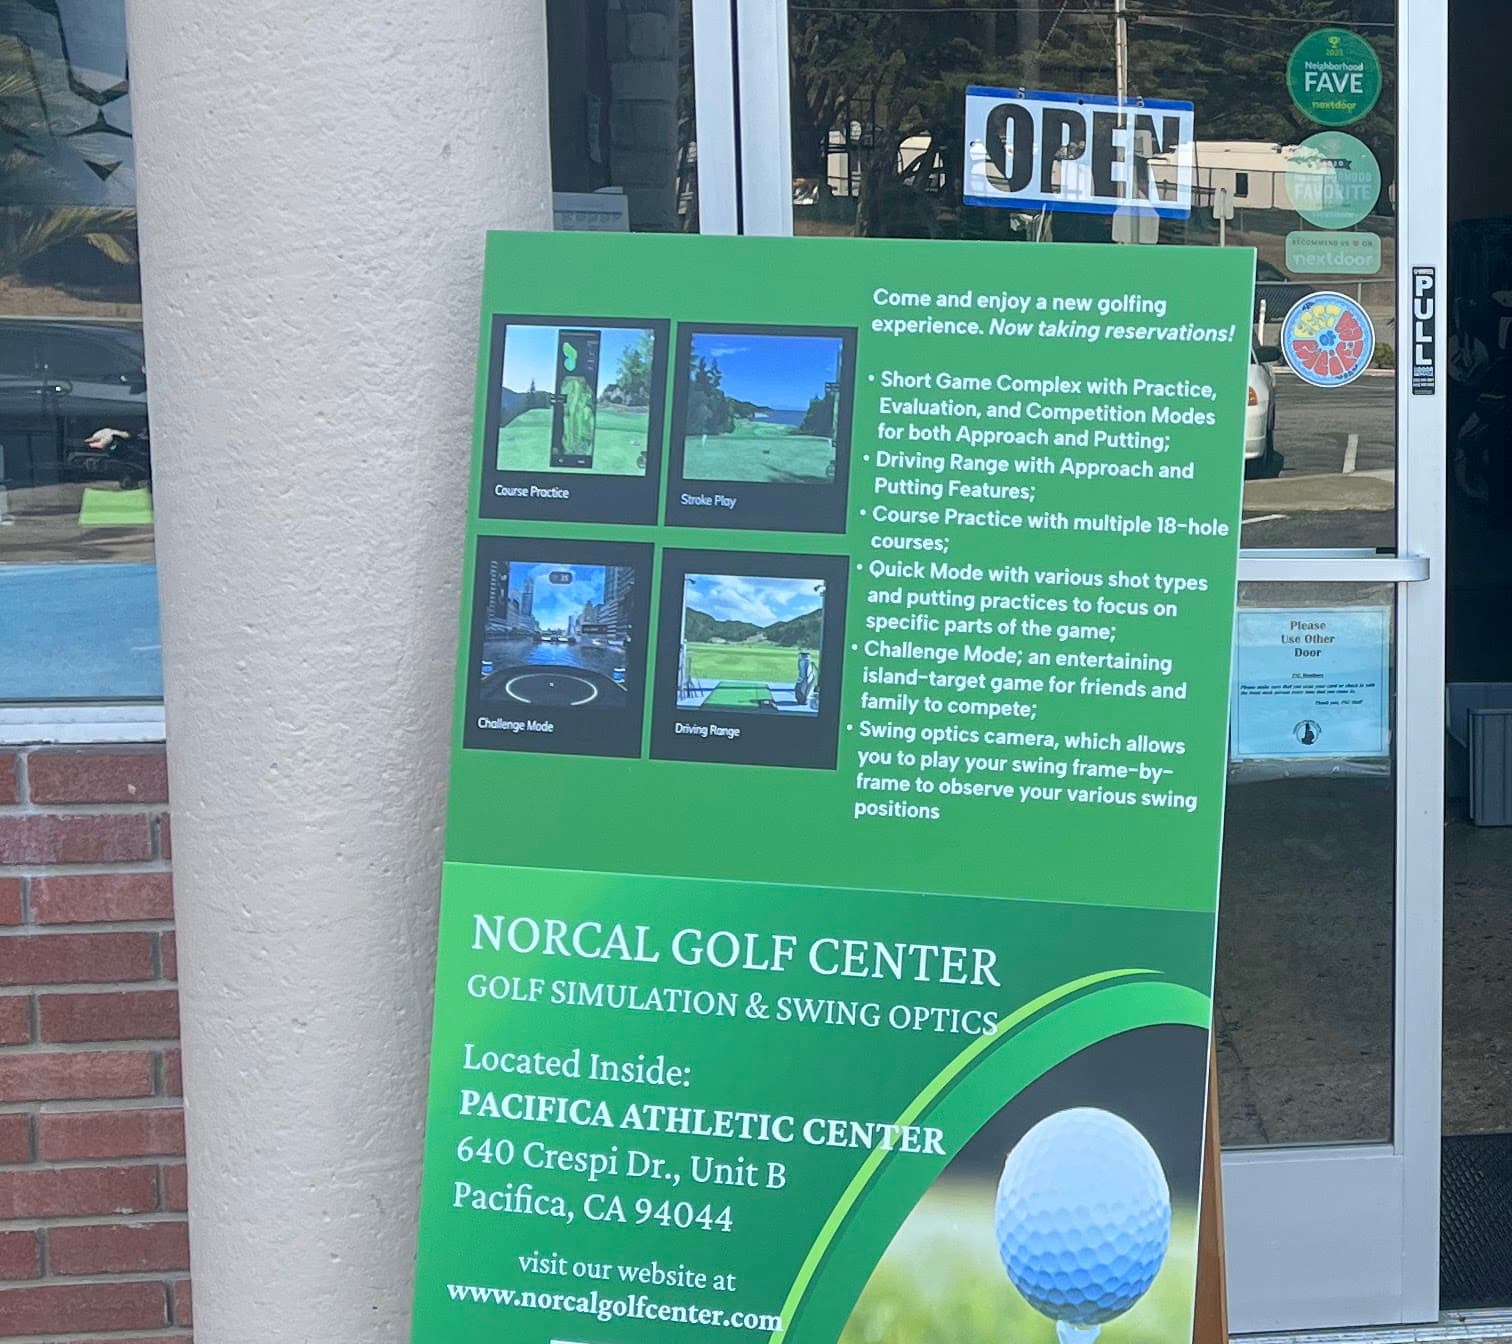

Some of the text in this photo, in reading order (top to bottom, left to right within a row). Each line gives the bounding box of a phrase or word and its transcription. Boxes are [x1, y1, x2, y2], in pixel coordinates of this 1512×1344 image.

[1304, 61, 1364, 73] Neighborhood
[1304, 71, 1364, 94] FAVE
[1311, 100, 1356, 111] nextdoor
[985, 102, 1181, 203] OPEN
[1294, 183, 1372, 201] FAVORITE
[1292, 251, 1374, 266] nextdoor
[873, 288, 1166, 317] Come and enjoy a new golfing
[872, 316, 1236, 342] experience. Now taking reservations!
[1413, 275, 1434, 366] PULL
[881, 370, 1216, 400] Short Game Complex with Practice,
[880, 397, 1215, 425] Evaluation, and Competition Modes
[878, 422, 1170, 453] for both Approach and Putting;
[876, 451, 1194, 479] Driving Range with Approach and
[495, 484, 569, 498] Course Practice
[681, 494, 736, 509] Stroke Play
[875, 477, 1035, 502] Putting Features;
[873, 505, 1229, 536] Course Practice with multiple 18-hole
[871, 536, 949, 554] courses;
[869, 560, 1208, 594] Quick Mode with various shot types
[868, 587, 1177, 616] and putting practices to focus on
[866, 614, 1116, 642] specific parts of the game;
[1280, 633, 1336, 645] Use Other
[1289, 620, 1327, 631] Please
[864, 640, 1172, 675] Challenge Mode; an entertaining
[1293, 647, 1323, 658] Door
[863, 666, 1187, 699] island-target game for friends and
[861, 692, 1036, 720] family to compete;
[478, 717, 553, 733] Challenge Mode
[675, 723, 740, 739] Driving Range
[860, 721, 1185, 754] Swing optics camera, which allows
[858, 750, 1173, 784] you to play your swing frame-by-
[857, 772, 1197, 812] frame to observe your various swing
[855, 800, 940, 819] positions
[472, 914, 1000, 986] NORCAL GOLF CENTER
[468, 975, 1000, 1037] GOLF SIMULATION & SWING OPTICS
[464, 1044, 690, 1087] Located Inside:
[460, 1090, 946, 1156] PACIFICA ATHLETIC CENTER
[458, 1136, 785, 1188] 640 Crespi Dr., Unit B
[454, 1182, 733, 1231] Pacifica, CA 94044
[519, 1251, 736, 1291] visit our website at
[447, 1284, 784, 1333] www.norcalgolfcenter.com
